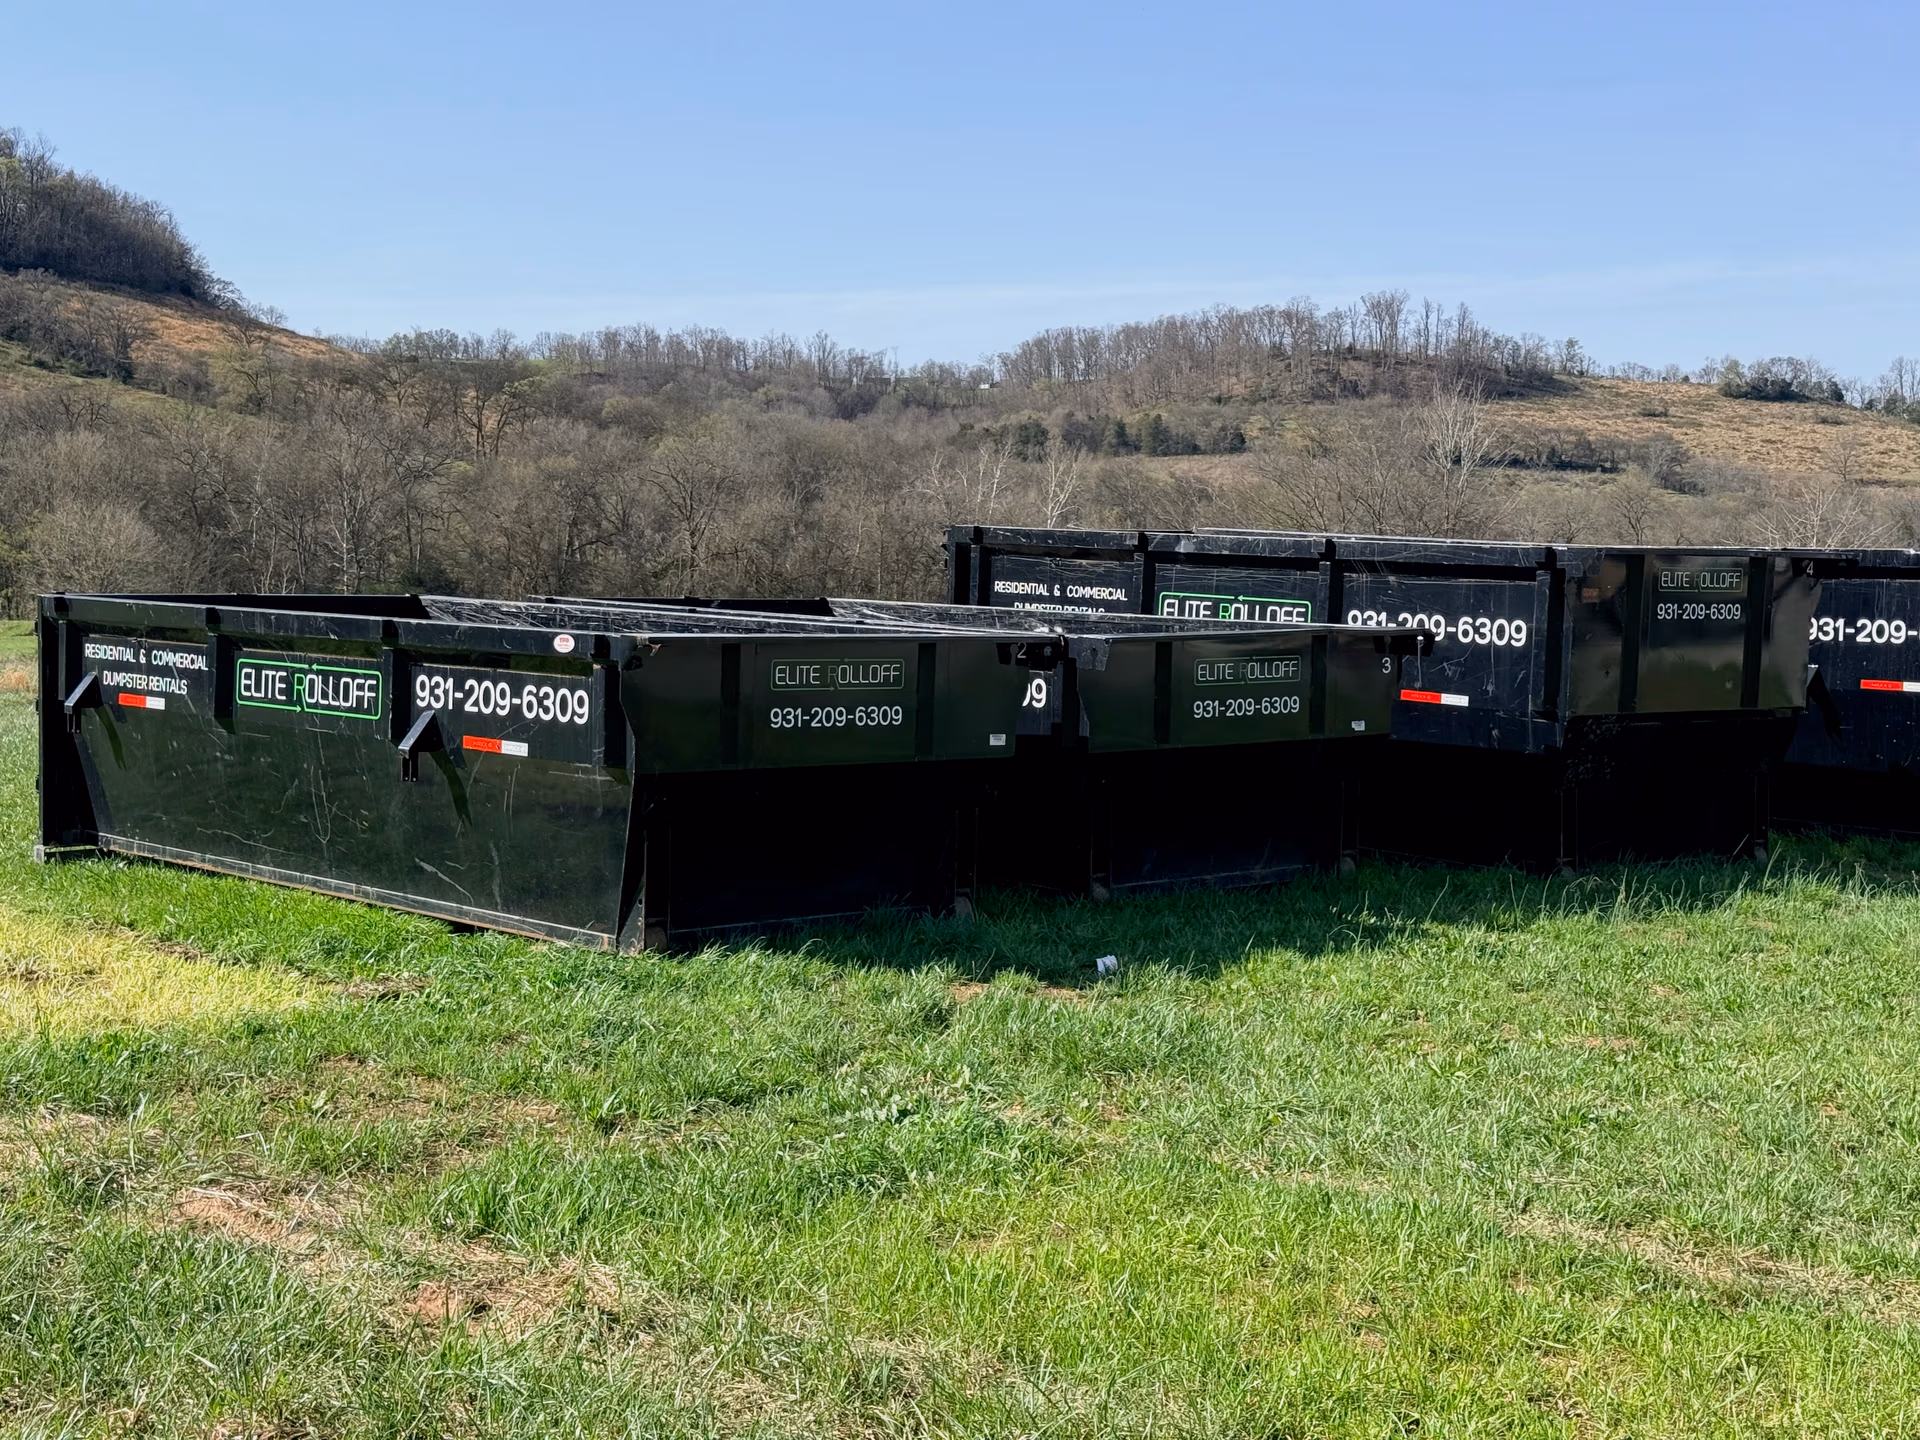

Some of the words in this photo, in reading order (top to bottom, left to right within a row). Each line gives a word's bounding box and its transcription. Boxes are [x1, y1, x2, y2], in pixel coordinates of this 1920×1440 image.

[1661, 571, 1691, 587] ELITE
[1694, 572, 1741, 588] ROLLOFF
[1806, 561, 1814, 576] 4
[994, 580, 1050, 596] RESIDENTIAL
[1053, 584, 1061, 597] &
[1066, 585, 1128, 601] COMMERCIAL
[1657, 603, 1742, 620] 931-209-6309
[1808, 617, 1920, 645] 931-209-
[85, 643, 136, 662] RESIDENTIAL
[140, 649, 147, 664] &
[151, 650, 209, 671] COMMERCIAL
[1017, 641, 1027, 659] 2
[775, 665, 821, 685] ELITE
[827, 664, 900, 687] ROLLOFF
[1198, 663, 1234, 681] ELITE
[1239, 660, 1298, 681] ROLLOFF
[1381, 657, 1392, 674] 3
[103, 670, 148, 690] DUMPSTER
[149, 679, 188, 695] RENTALS
[241, 668, 288, 700] ELITE
[293, 673, 377, 711] ROLLOFF
[415, 674, 590, 725] 931-209-6309
[1193, 696, 1300, 719] 931-209-6309
[770, 706, 903, 729] 931-209-6309
